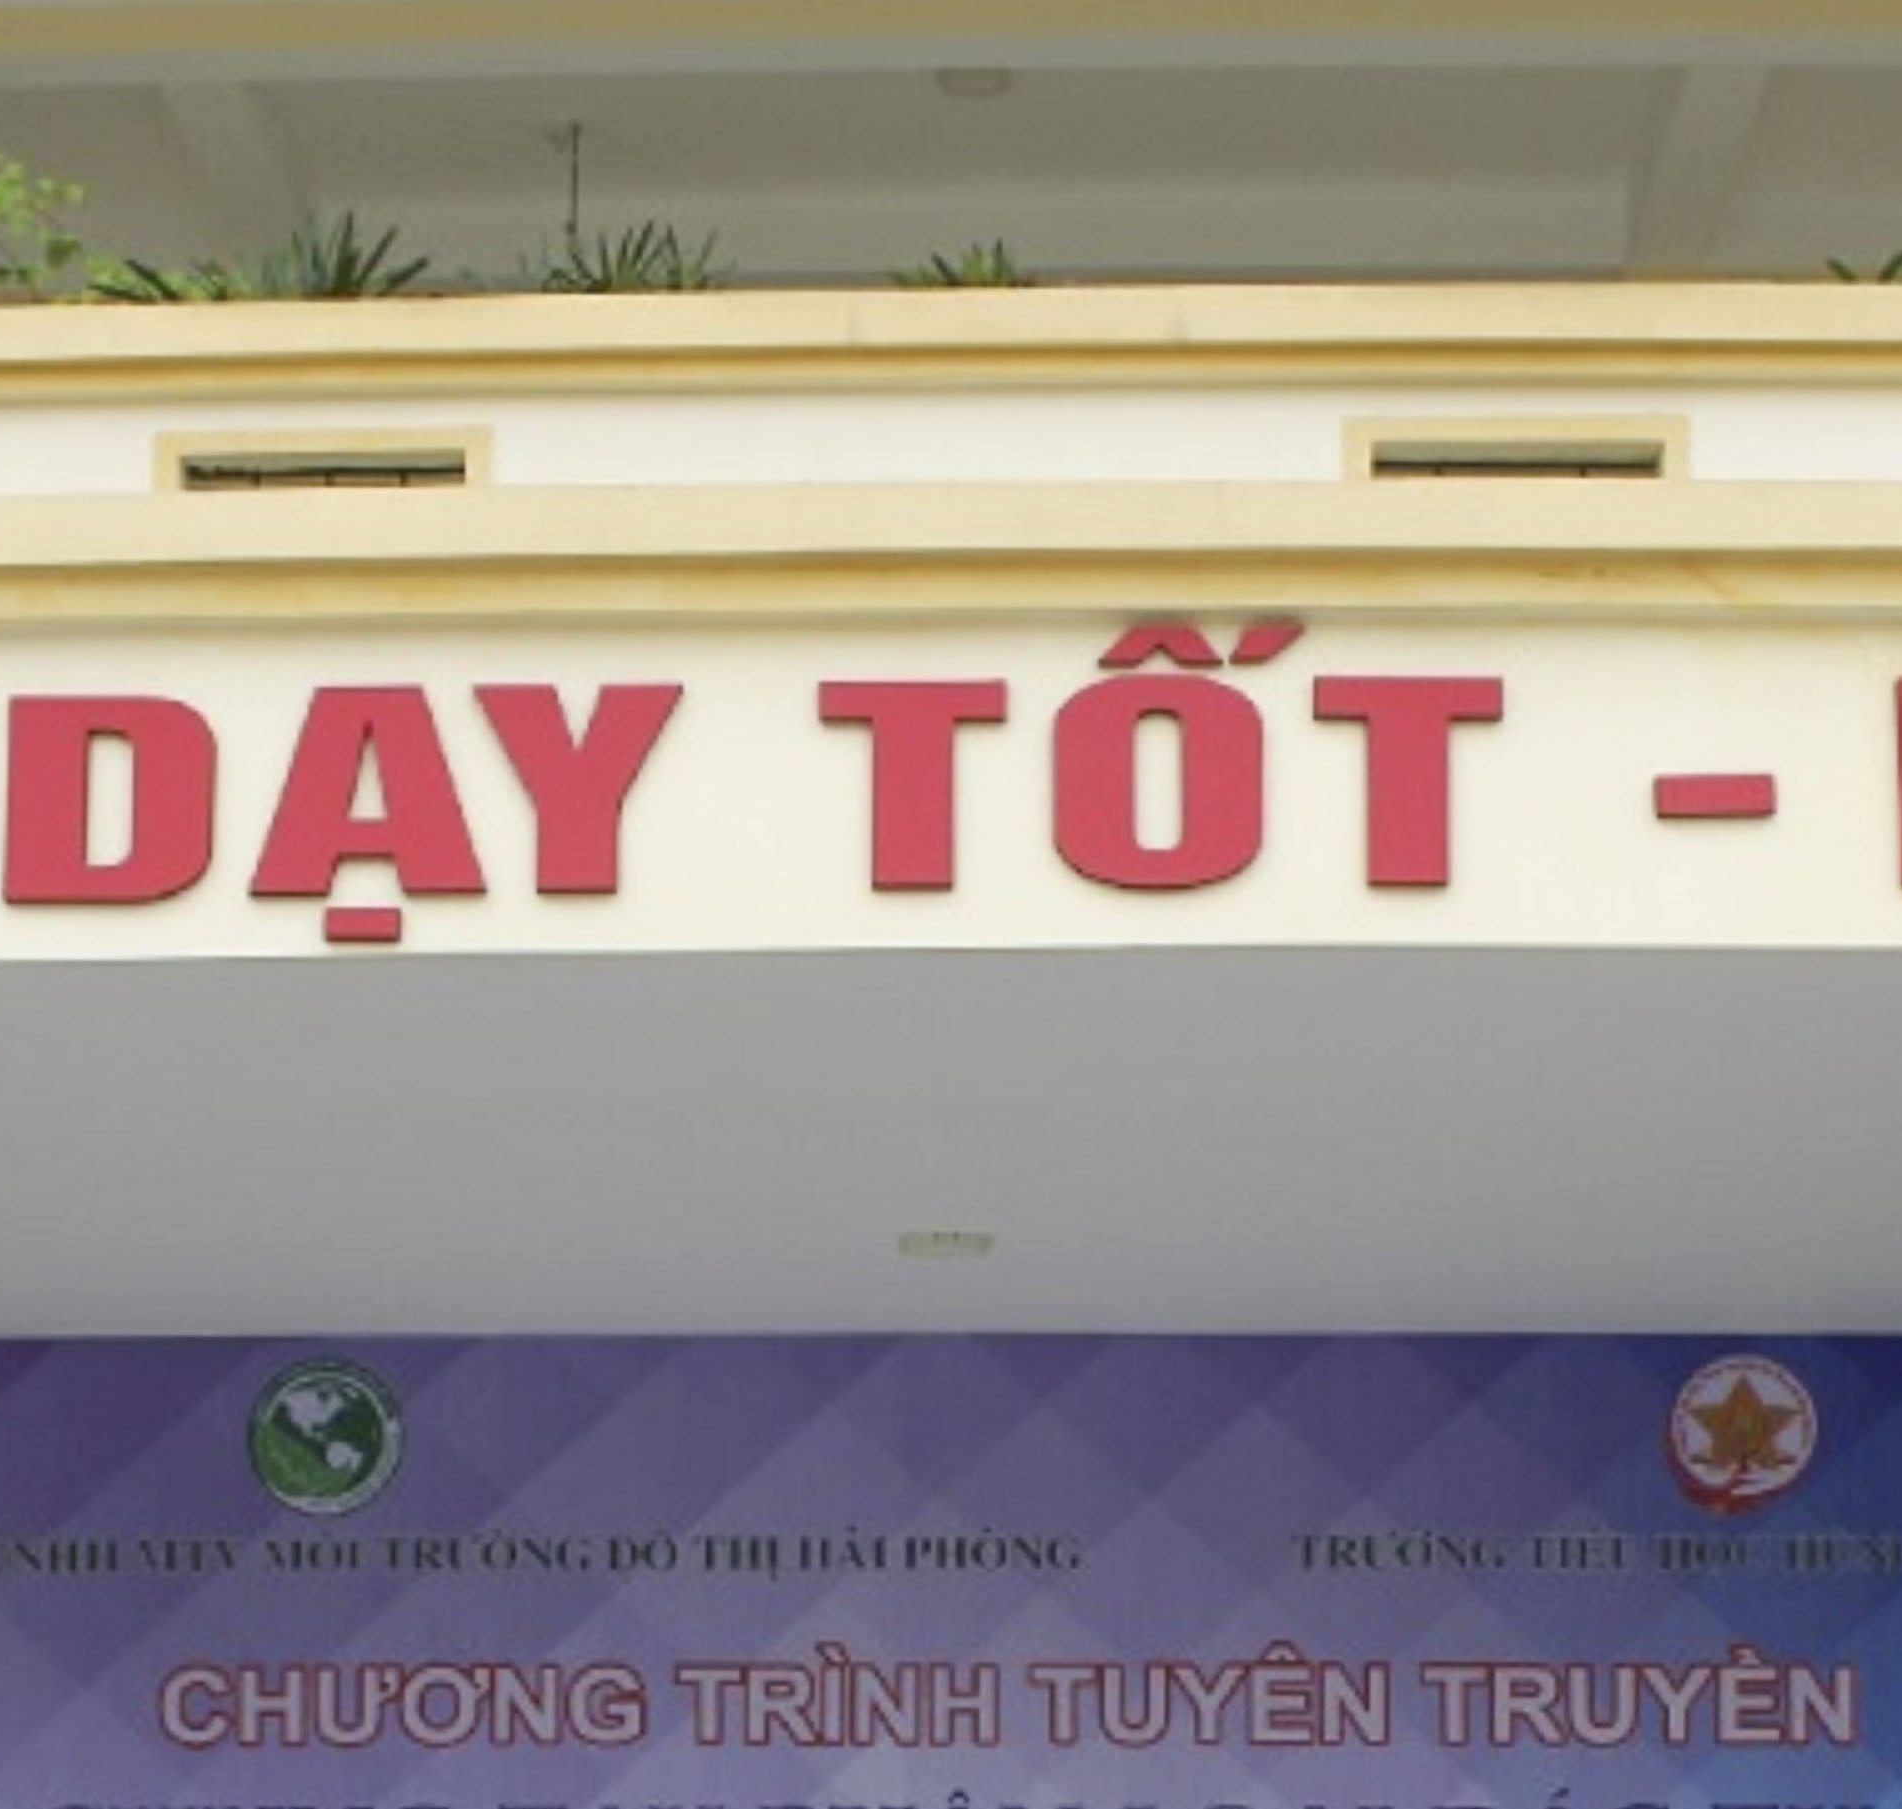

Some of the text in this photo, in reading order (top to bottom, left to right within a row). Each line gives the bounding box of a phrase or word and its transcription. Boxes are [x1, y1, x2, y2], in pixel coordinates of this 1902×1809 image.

[4, 684, 682, 943] DẠY
[820, 620, 1504, 893] TỐT
[1654, 774, 1776, 819] -
[693, 1535, 781, 1582] THỊ
[160, 1641, 1859, 1750] CHƯƠNG TRÌNH TUYÊN TRUYỀN
